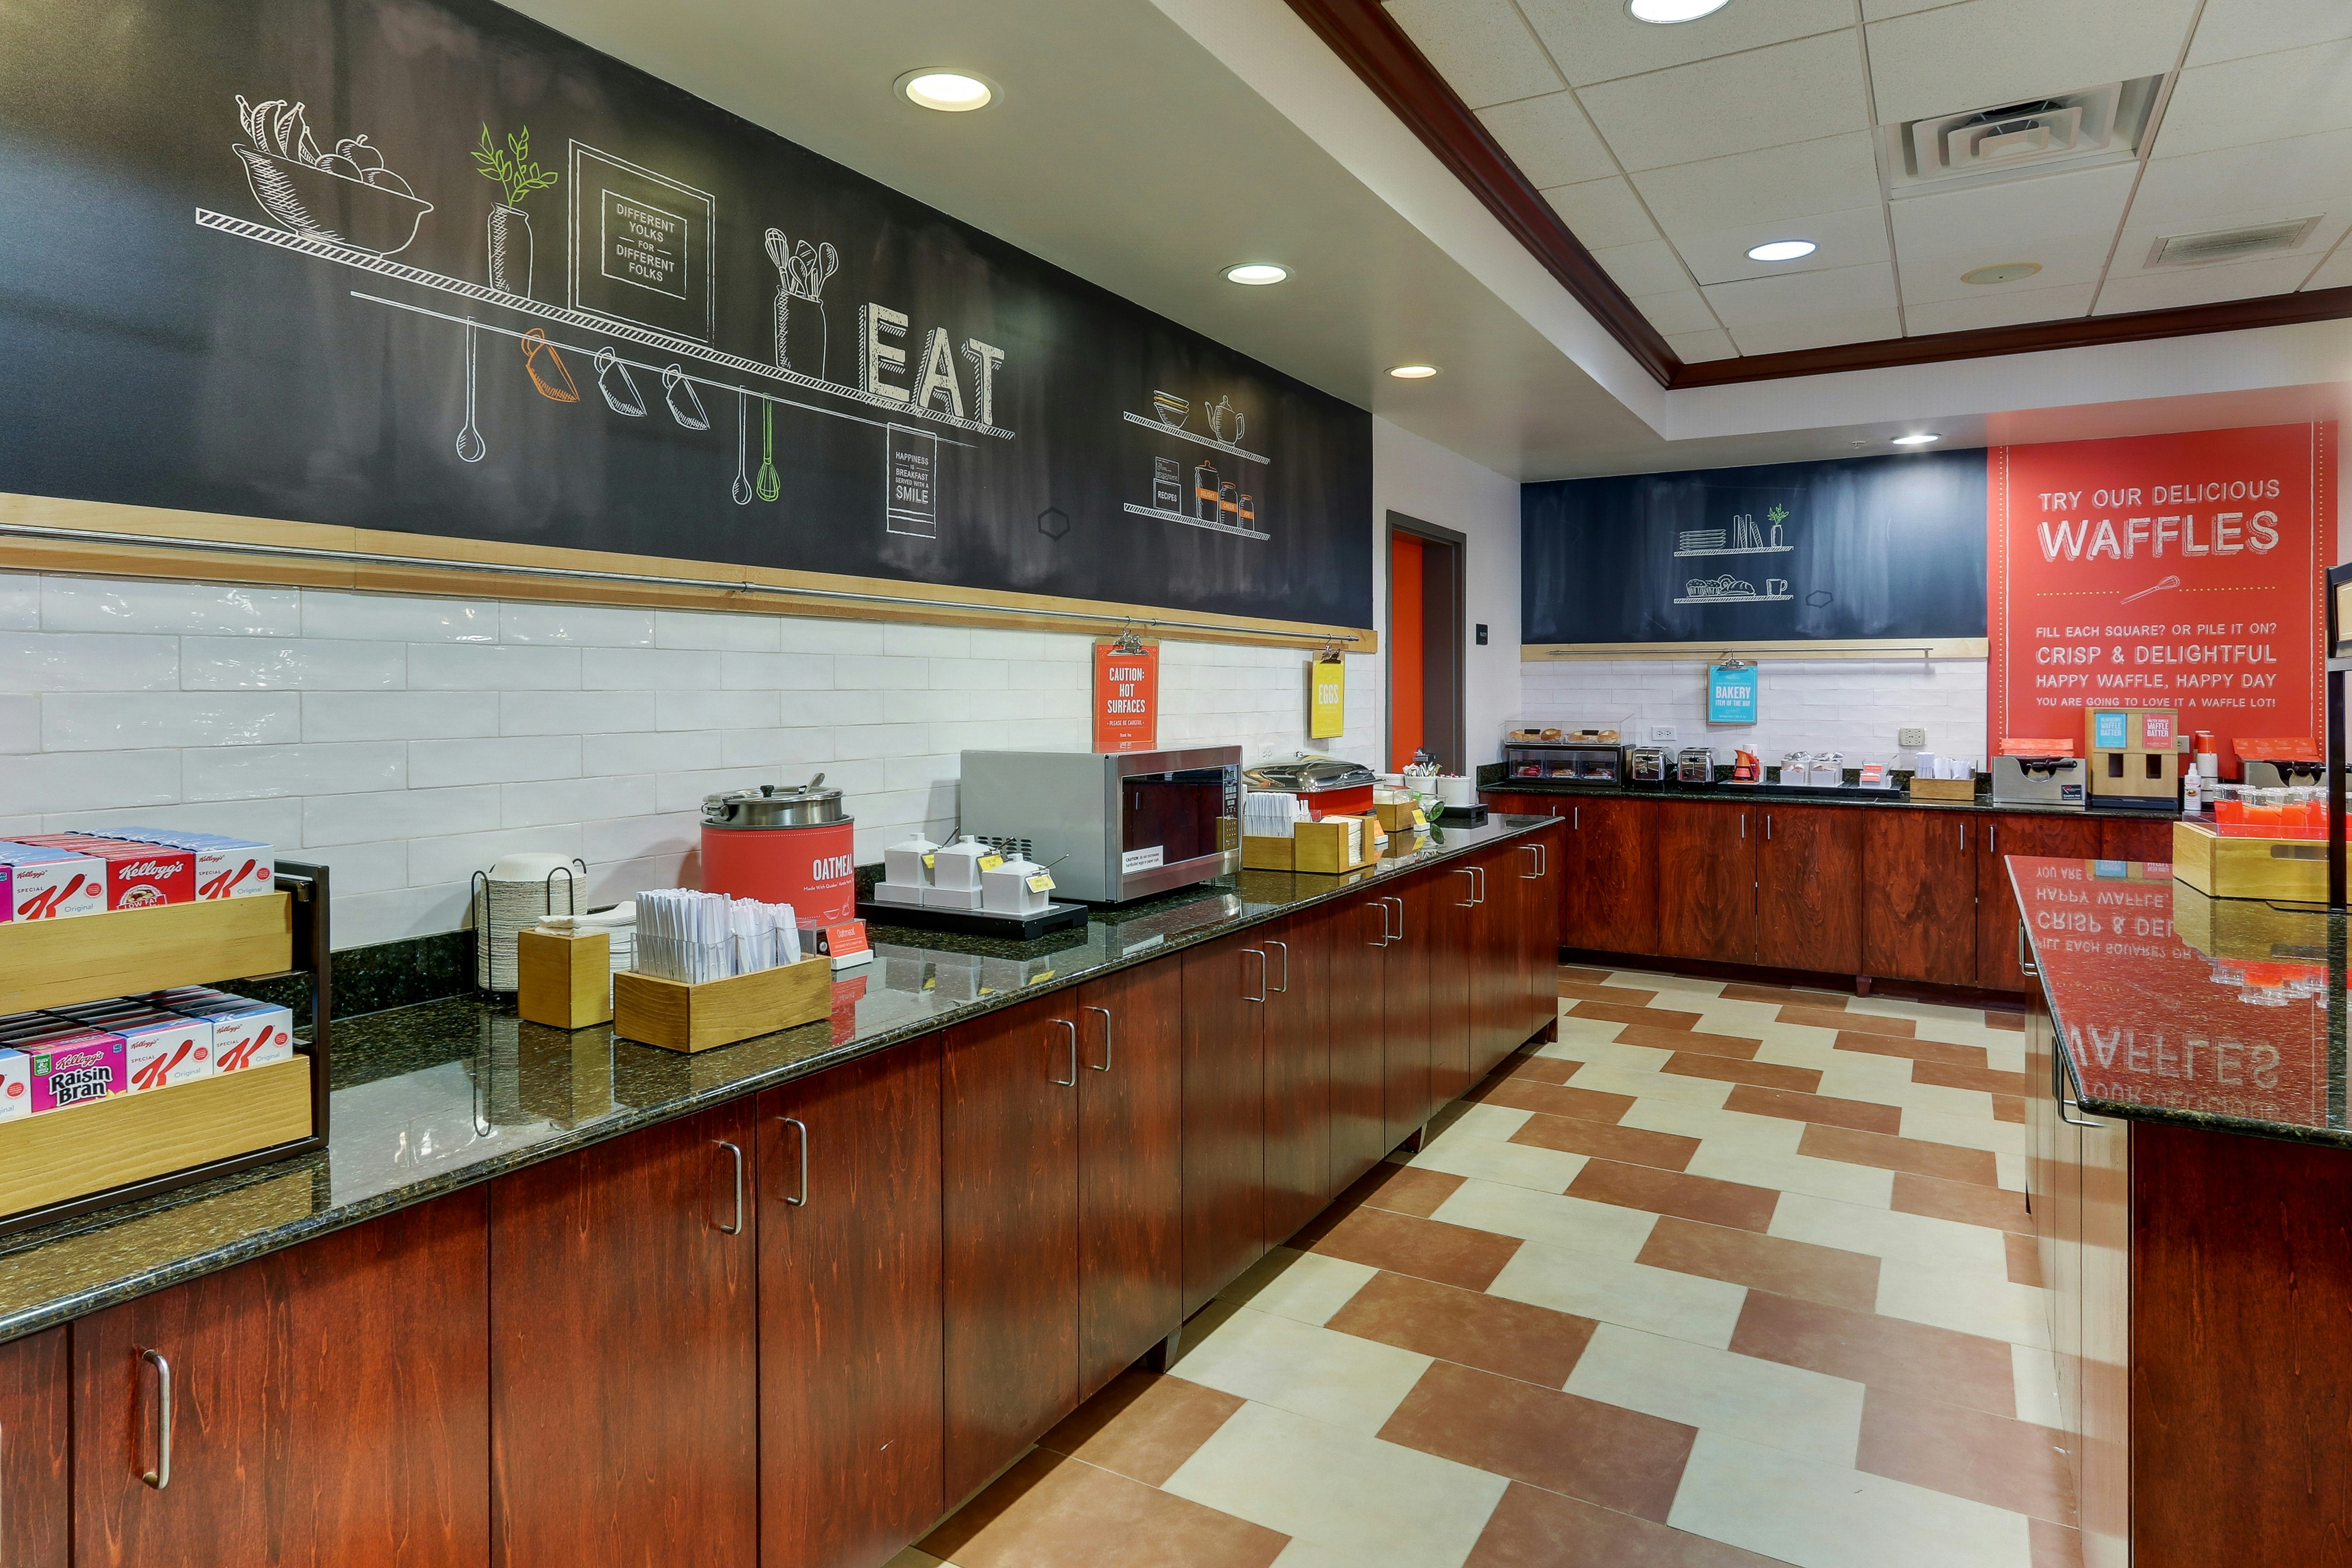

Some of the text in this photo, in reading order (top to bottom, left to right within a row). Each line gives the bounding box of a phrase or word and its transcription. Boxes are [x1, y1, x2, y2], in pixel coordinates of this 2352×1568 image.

[616, 203, 675, 233] DIFFERENT
[629, 221, 663, 242] YOLKS
[638, 240, 654, 252] FOR
[616, 244, 675, 272] DIFFERENT
[629, 262, 663, 282] FOLKS
[859, 302, 1005, 426] EAT
[895, 451, 929, 465] HAPPINESS
[895, 477, 912, 486] SERVED
[896, 468, 928, 481] BREAKFAST
[895, 485, 928, 504] SMILE
[1158, 491, 1177, 502] RECIPES
[2038, 479, 2279, 512] TRY OUR DELICIOUS
[2037, 510, 2279, 562] WAFFLES
[2036, 622, 2277, 638] FILL EACH SQUARE? OR PILE IT ON?
[2036, 644, 2277, 665] CRISP & DELIGHTFUL
[1109, 667, 1145, 682] CAUTION:
[2036, 674, 2276, 689] HAPPY WAFFLE, HAPPY DAY
[1119, 683, 1135, 697] HOT
[1319, 684, 1339, 705] EGGS
[1715, 686, 1751, 699] BAKERY
[1107, 699, 1146, 713] SURFACES
[2037, 698, 2275, 707] YOU ARE GOING TO LOVE IT A WAFFLE LOT!
[17, 870, 46, 879] Kellogg's
[119, 860, 184, 880] Kellogg's
[813, 853, 852, 881] OATMEAL
[65, 904, 93, 913] Original
[837, 927, 856, 938] Oatmeal
[216, 1024, 241, 1034] Kellogg's
[131, 1039, 158, 1049] Kellogg's
[55, 1051, 104, 1070] Kellogg's
[256, 1053, 280, 1062] Original
[49, 1067, 112, 1094] Raisin
[175, 1068, 201, 1078] Original
[57, 1081, 107, 1106] Bran
